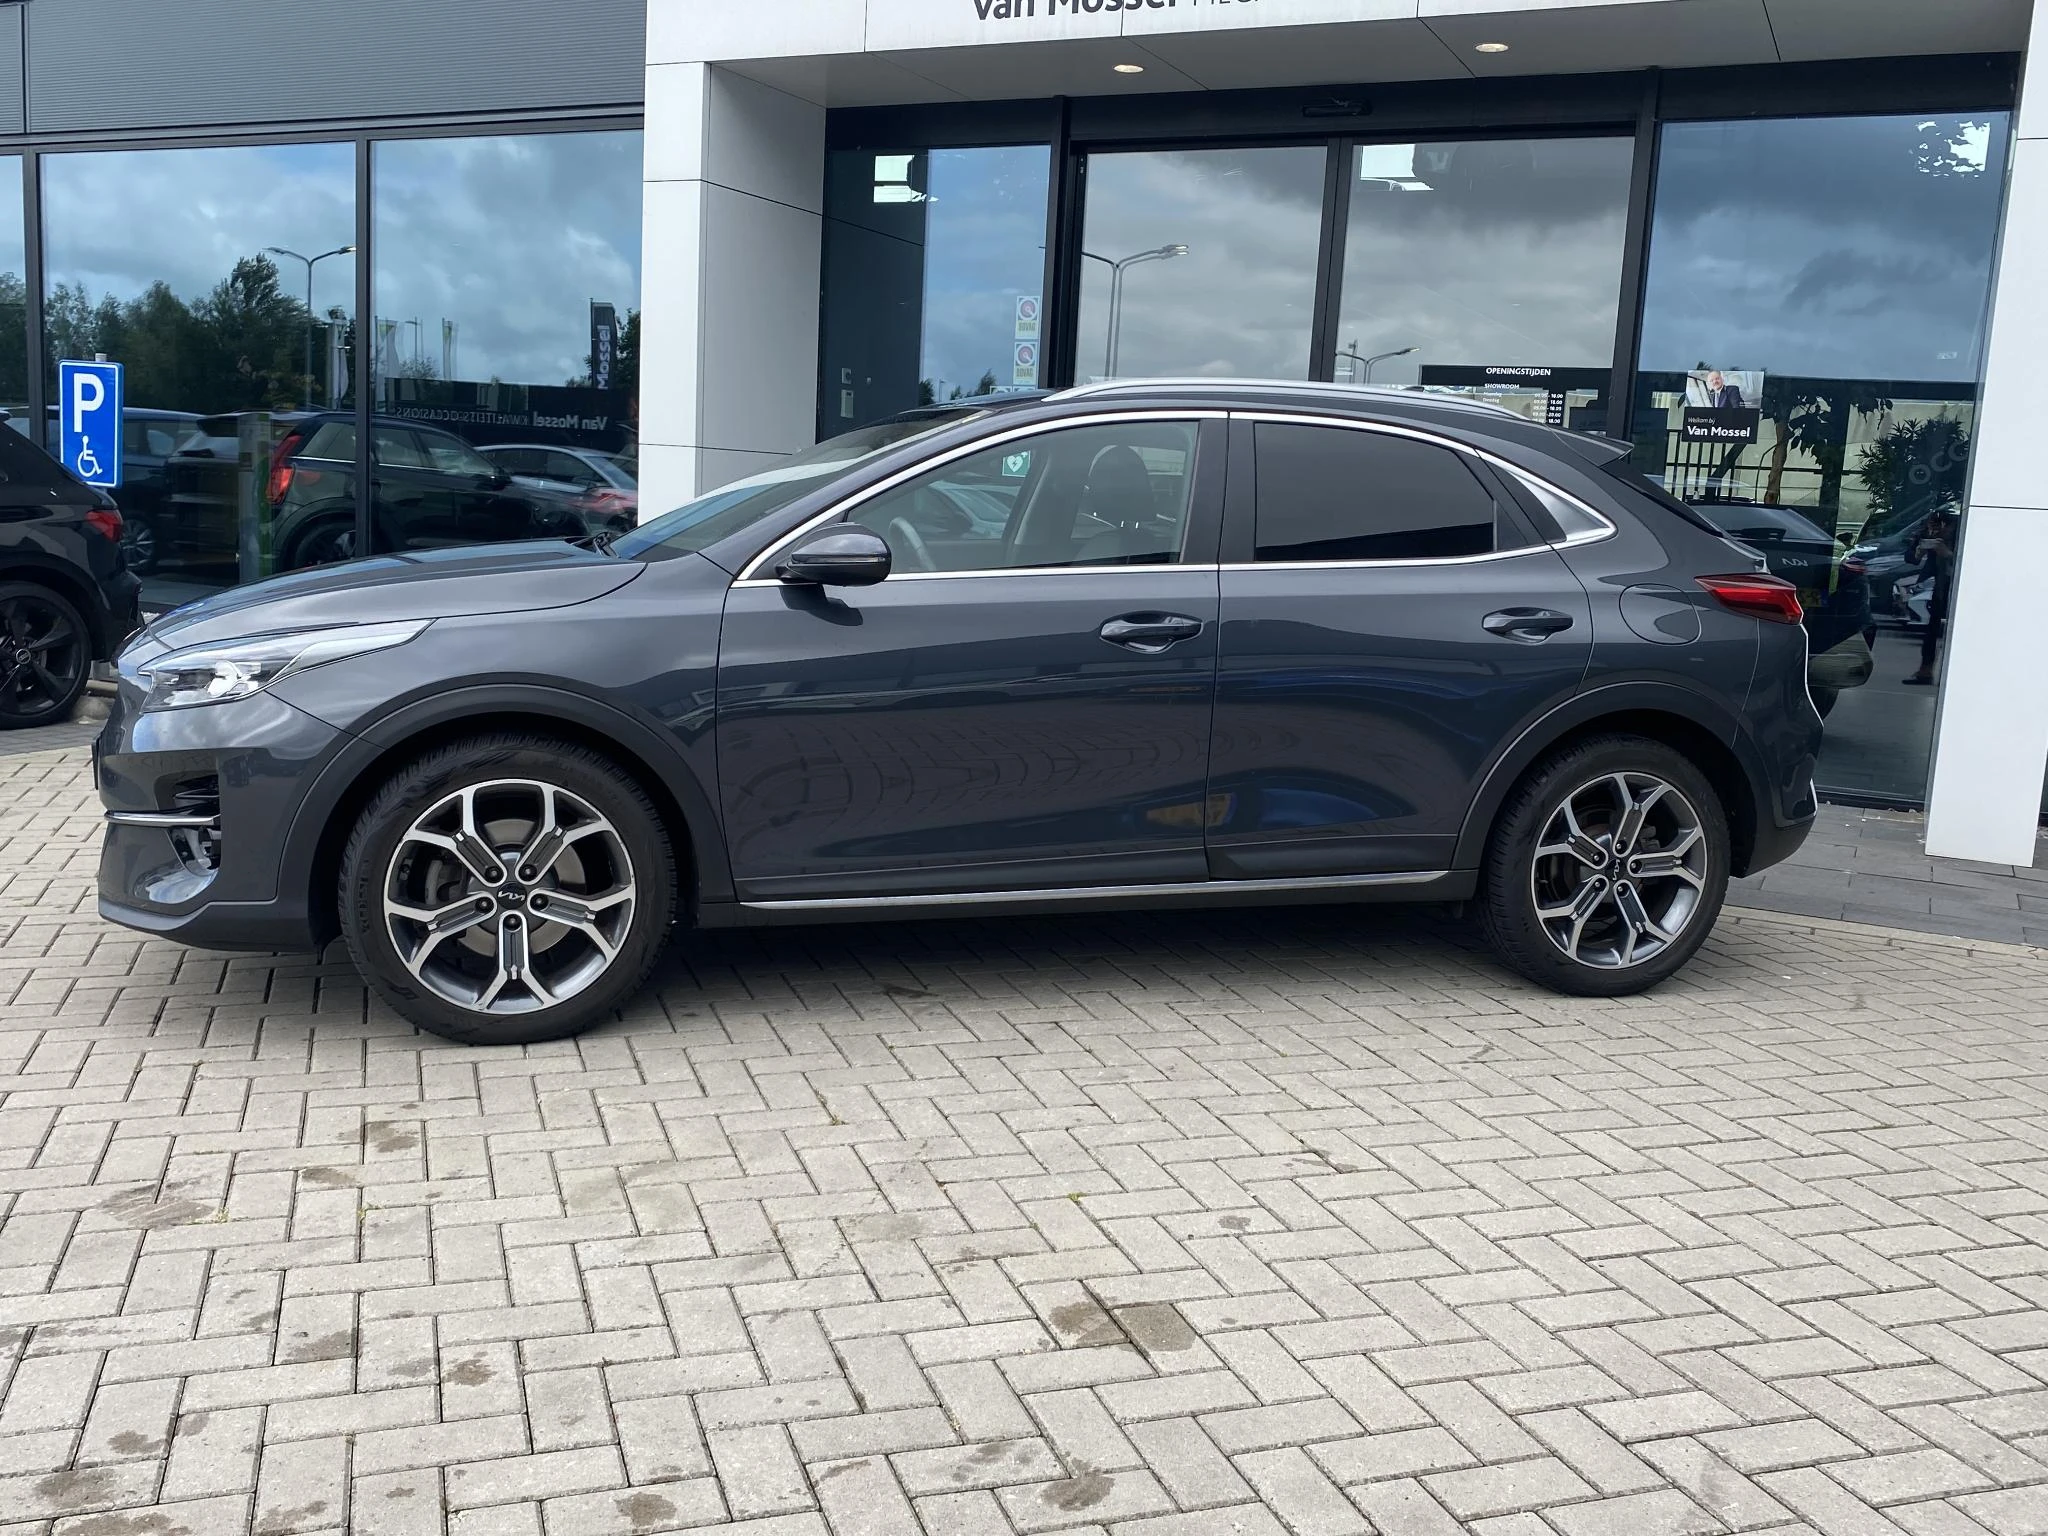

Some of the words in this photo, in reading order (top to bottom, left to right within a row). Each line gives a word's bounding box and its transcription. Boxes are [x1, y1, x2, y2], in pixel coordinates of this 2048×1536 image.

[1048, 0, 1176, 16] Mos
[1486, 368, 1551, 376] OPENINGSTIJDEN
[73, 373, 105, 433] P
[1687, 426, 1707, 436] Van
[1711, 427, 1750, 437] Mossel
